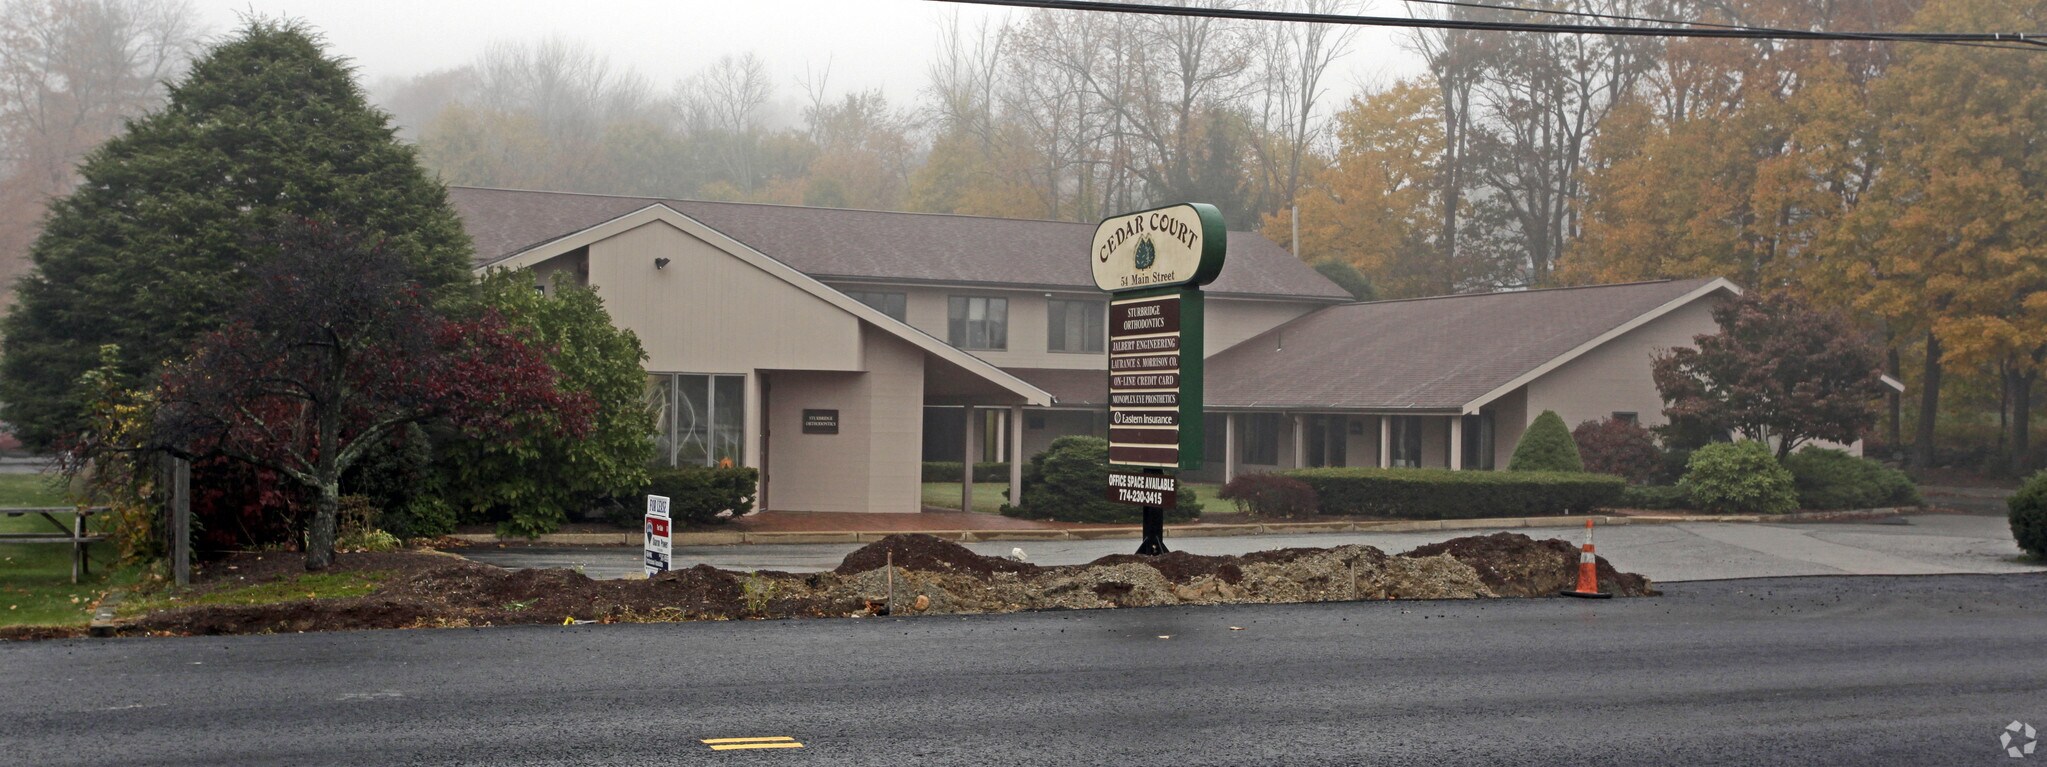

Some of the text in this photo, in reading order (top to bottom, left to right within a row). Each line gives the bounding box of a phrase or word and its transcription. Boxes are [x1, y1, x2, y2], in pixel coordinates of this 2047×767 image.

[1100, 213, 1198, 263] CEDAR COURT
[1121, 270, 1175, 286] 54 Main Street
[1127, 305, 1160, 318] STURBRIDGE
[1123, 317, 1164, 330] ORTHODONTICS
[1112, 338, 1175, 351] JALBERT ENGINEERING
[1142, 357, 1168, 367] MORRISON
[1113, 375, 1174, 386] ON-LINE CREDIT CARD
[1112, 394, 1175, 404] MONOPLEX EYE PROSTHETICS
[1122, 414, 1172, 424] Eastern Insurance
[1108, 474, 1174, 491] OFFICE SPACE AVAILABLE
[1119, 489, 1162, 504] 774-230-3415
[657, 500, 667, 513] LEASE
